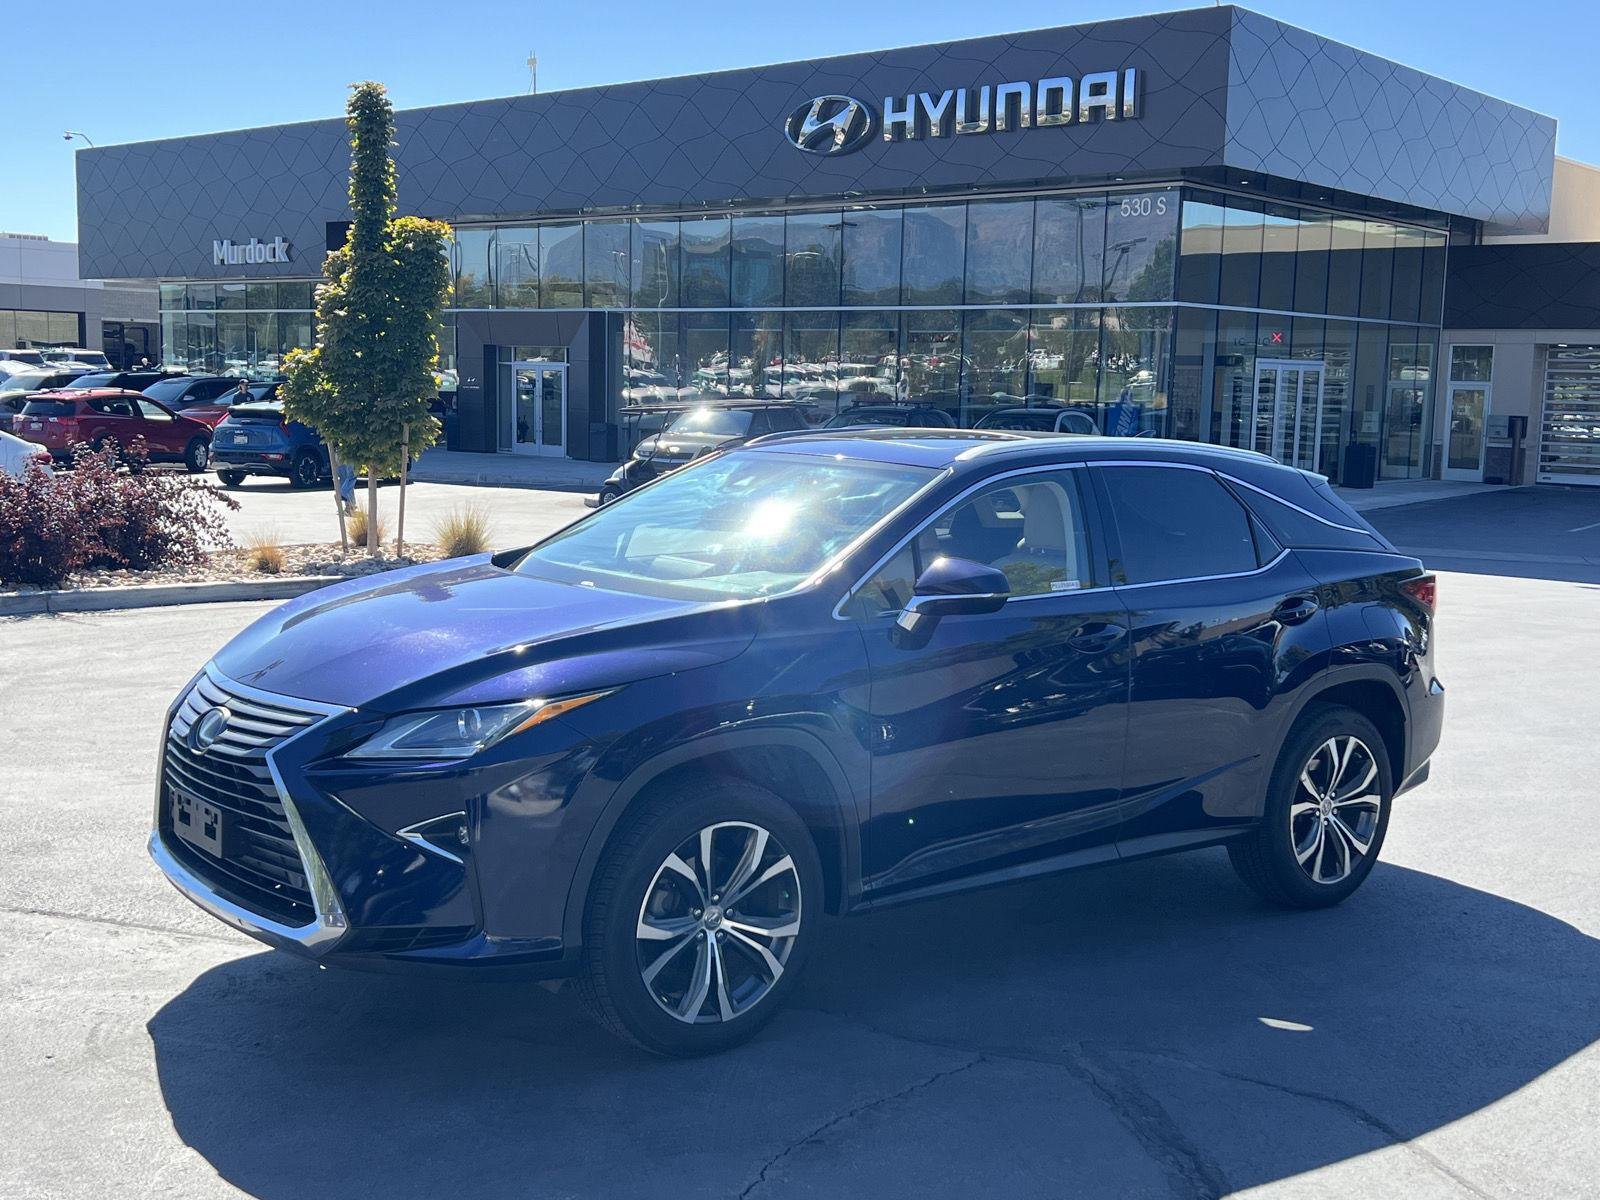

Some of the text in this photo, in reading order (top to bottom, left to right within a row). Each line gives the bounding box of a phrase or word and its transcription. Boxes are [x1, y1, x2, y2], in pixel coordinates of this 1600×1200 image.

[883, 67, 1137, 143] HYUNDAI
[1120, 196, 1167, 217] 530 S
[213, 236, 290, 265] Murdock
